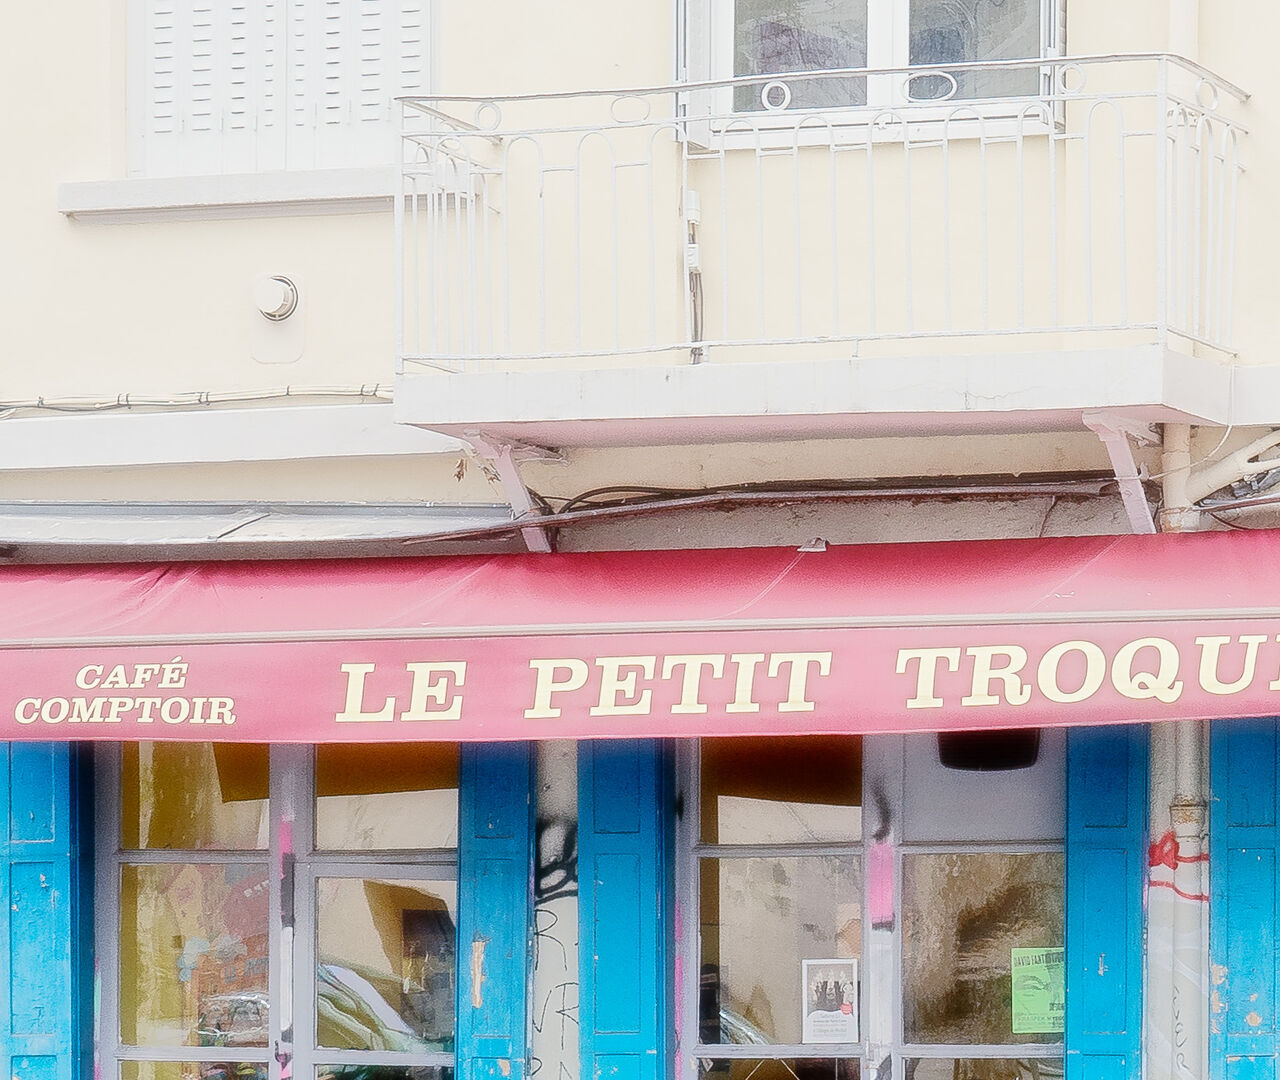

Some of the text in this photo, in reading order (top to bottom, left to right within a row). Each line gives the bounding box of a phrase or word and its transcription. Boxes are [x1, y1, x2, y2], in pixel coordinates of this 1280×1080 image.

[75, 656, 189, 689] CAFÉ
[334, 661, 467, 723] LE
[523, 651, 833, 720] PETIT
[13, 696, 237, 725] COMPTOIR
